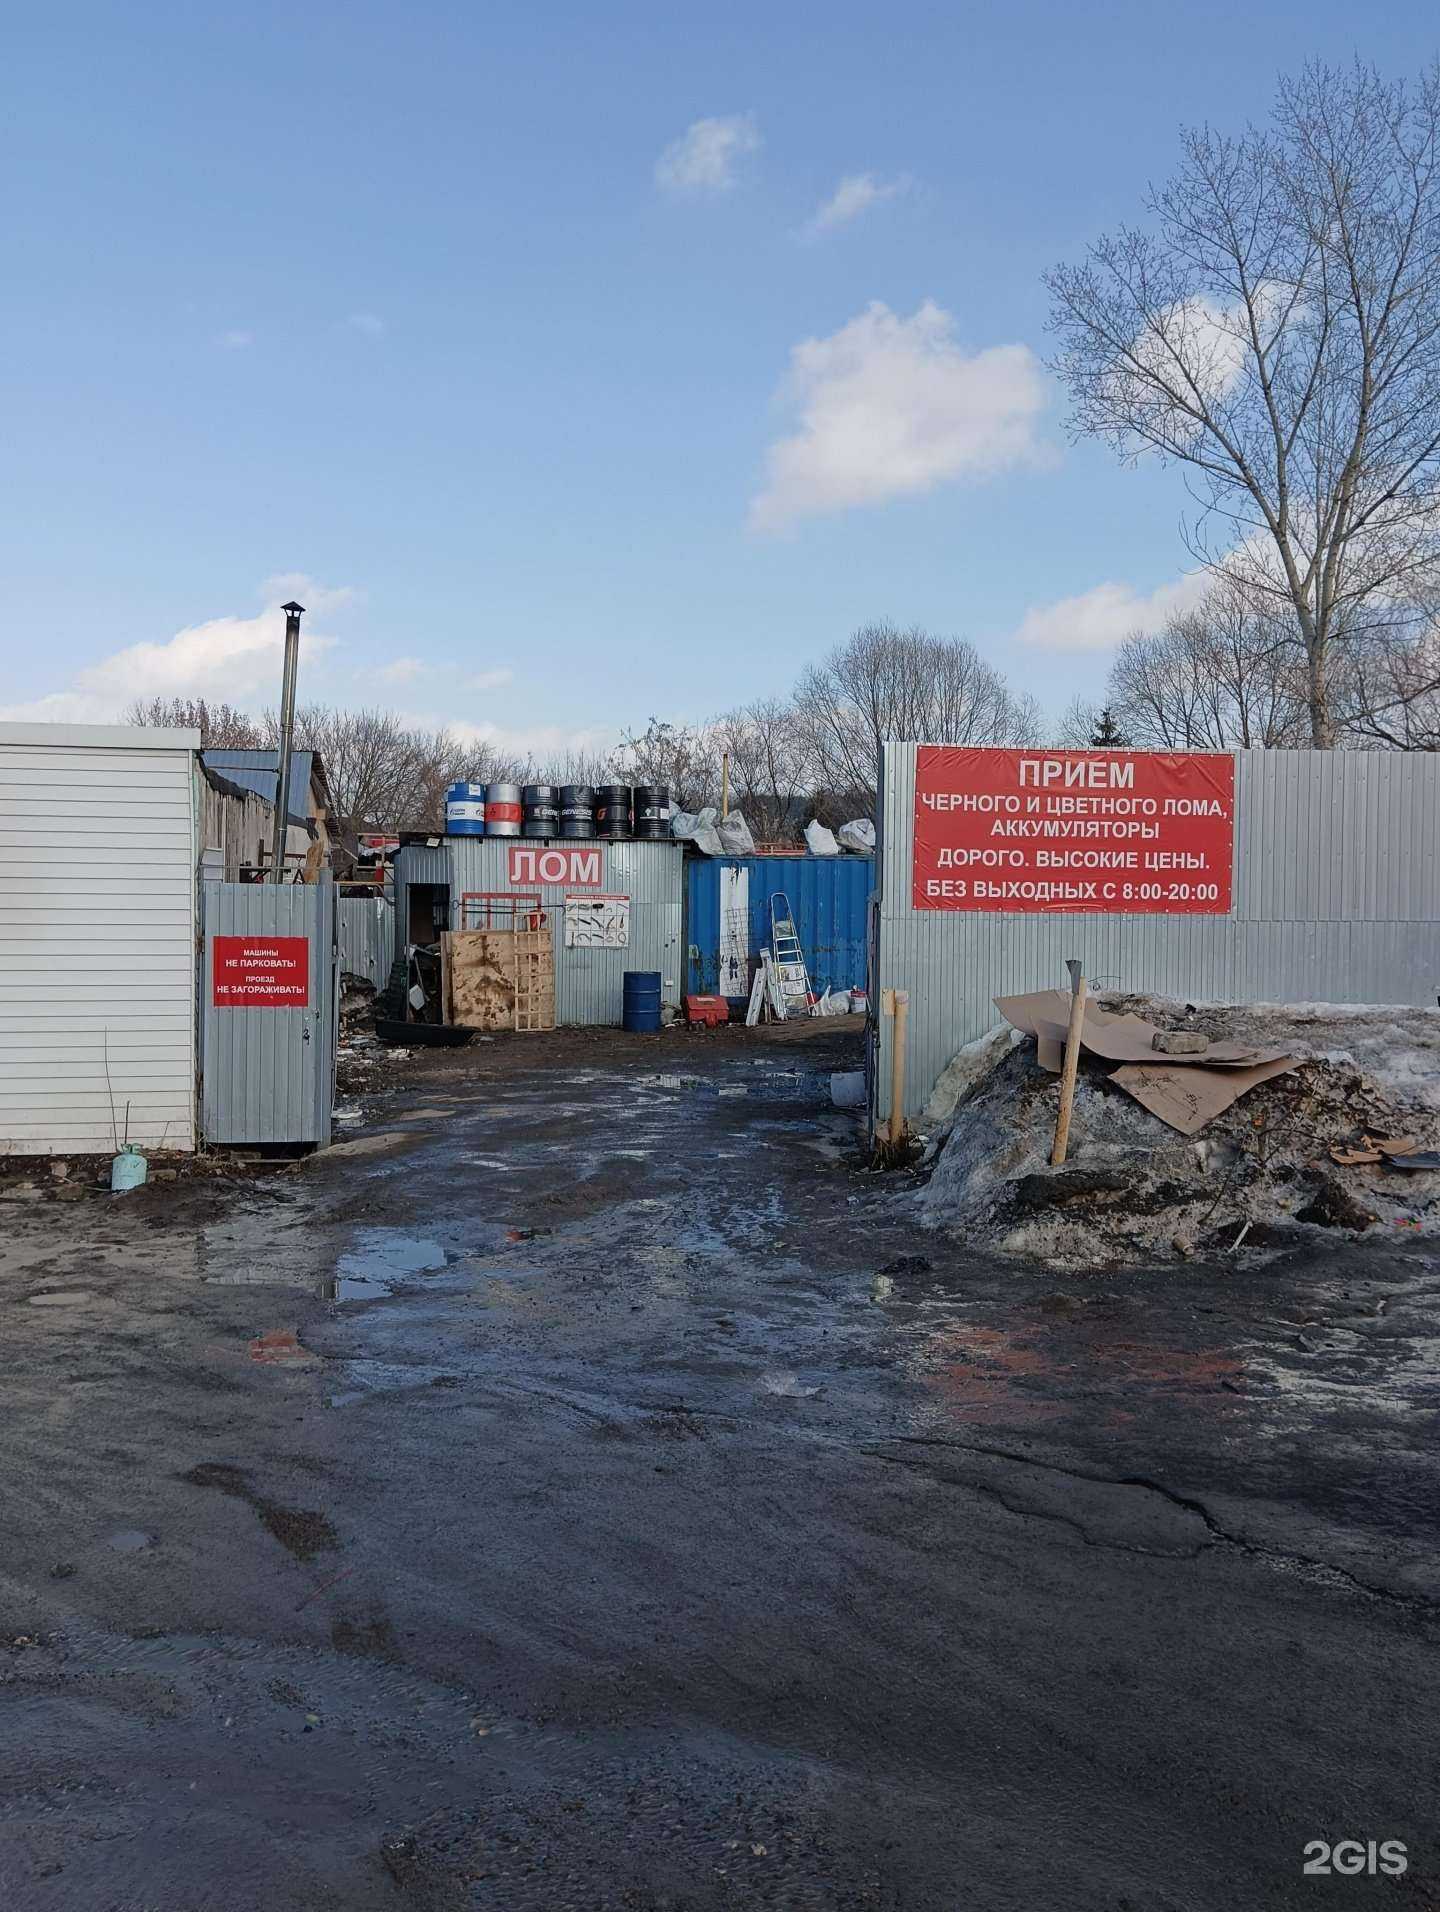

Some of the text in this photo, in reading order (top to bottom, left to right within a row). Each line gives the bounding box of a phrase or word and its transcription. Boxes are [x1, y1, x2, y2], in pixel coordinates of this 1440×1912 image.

[1019, 760, 1135, 789] ПРИЕМ
[922, 793, 1228, 819] ЧЕРНОГО И ЦВЕТНОГО ЛОМА,
[990, 819, 1160, 839] АККУМУЛЯТОРЫ
[511, 851, 600, 883] ЛОМ
[937, 848, 1210, 871] ДОРОГО. ВЫСОКИЕ ЦЕНЫ.
[926, 880, 1219, 902] БЕЗ ВЫХОДНЫХ С 8:00-20:00
[225, 959, 296, 968] НЕ ПАРКОВАТЬ!
[243, 949, 279, 957] МАШИНЫ
[217, 985, 305, 994] НЕ ЗАГОРАЖИВАТЬ!
[245, 975, 275, 983] ПРОЕЗД
